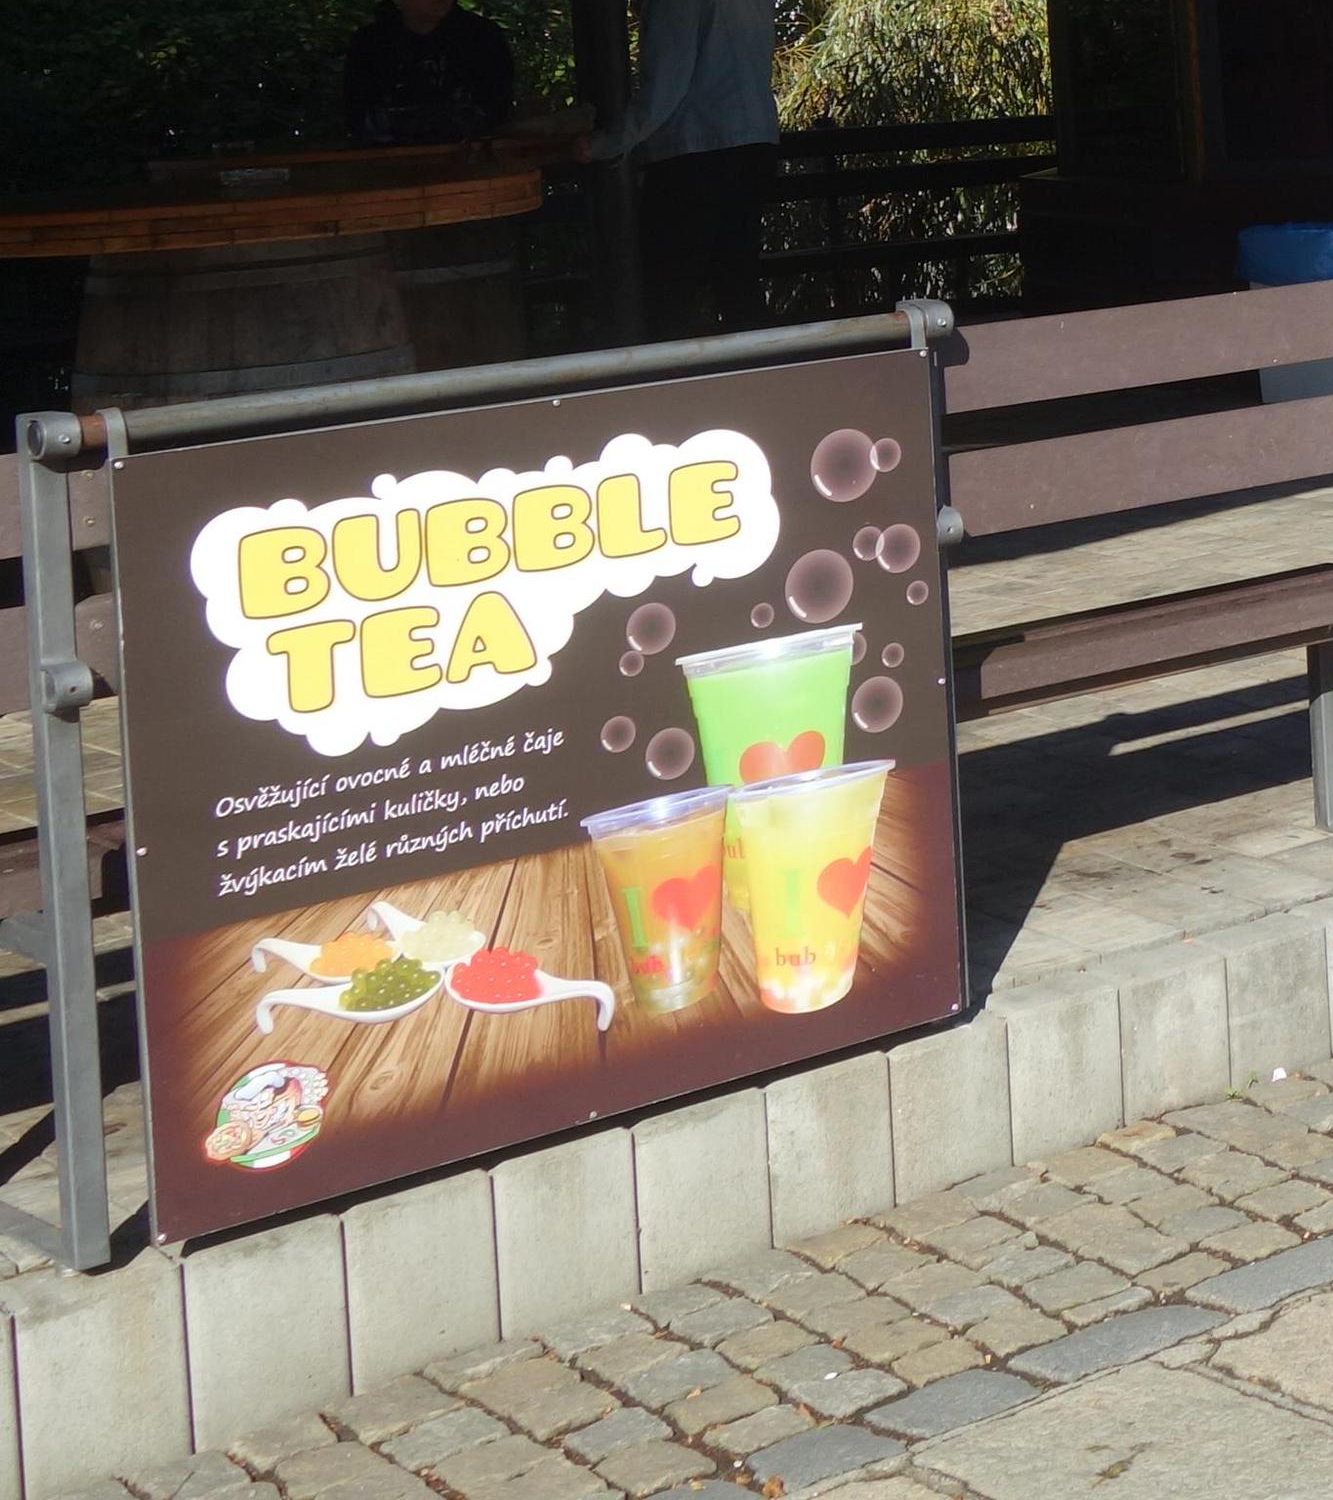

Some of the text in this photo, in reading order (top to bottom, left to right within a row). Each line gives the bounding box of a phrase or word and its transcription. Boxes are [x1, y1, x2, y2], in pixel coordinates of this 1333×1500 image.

[238, 460, 741, 620] BUBBLE
[266, 591, 537, 713] TEA
[215, 727, 564, 819] Osvěžující ovocné a mléčné čaje
[216, 773, 525, 859] s praskajícími kuličky, nebo
[218, 798, 570, 897] žvýkacím želé různých příchutí.
